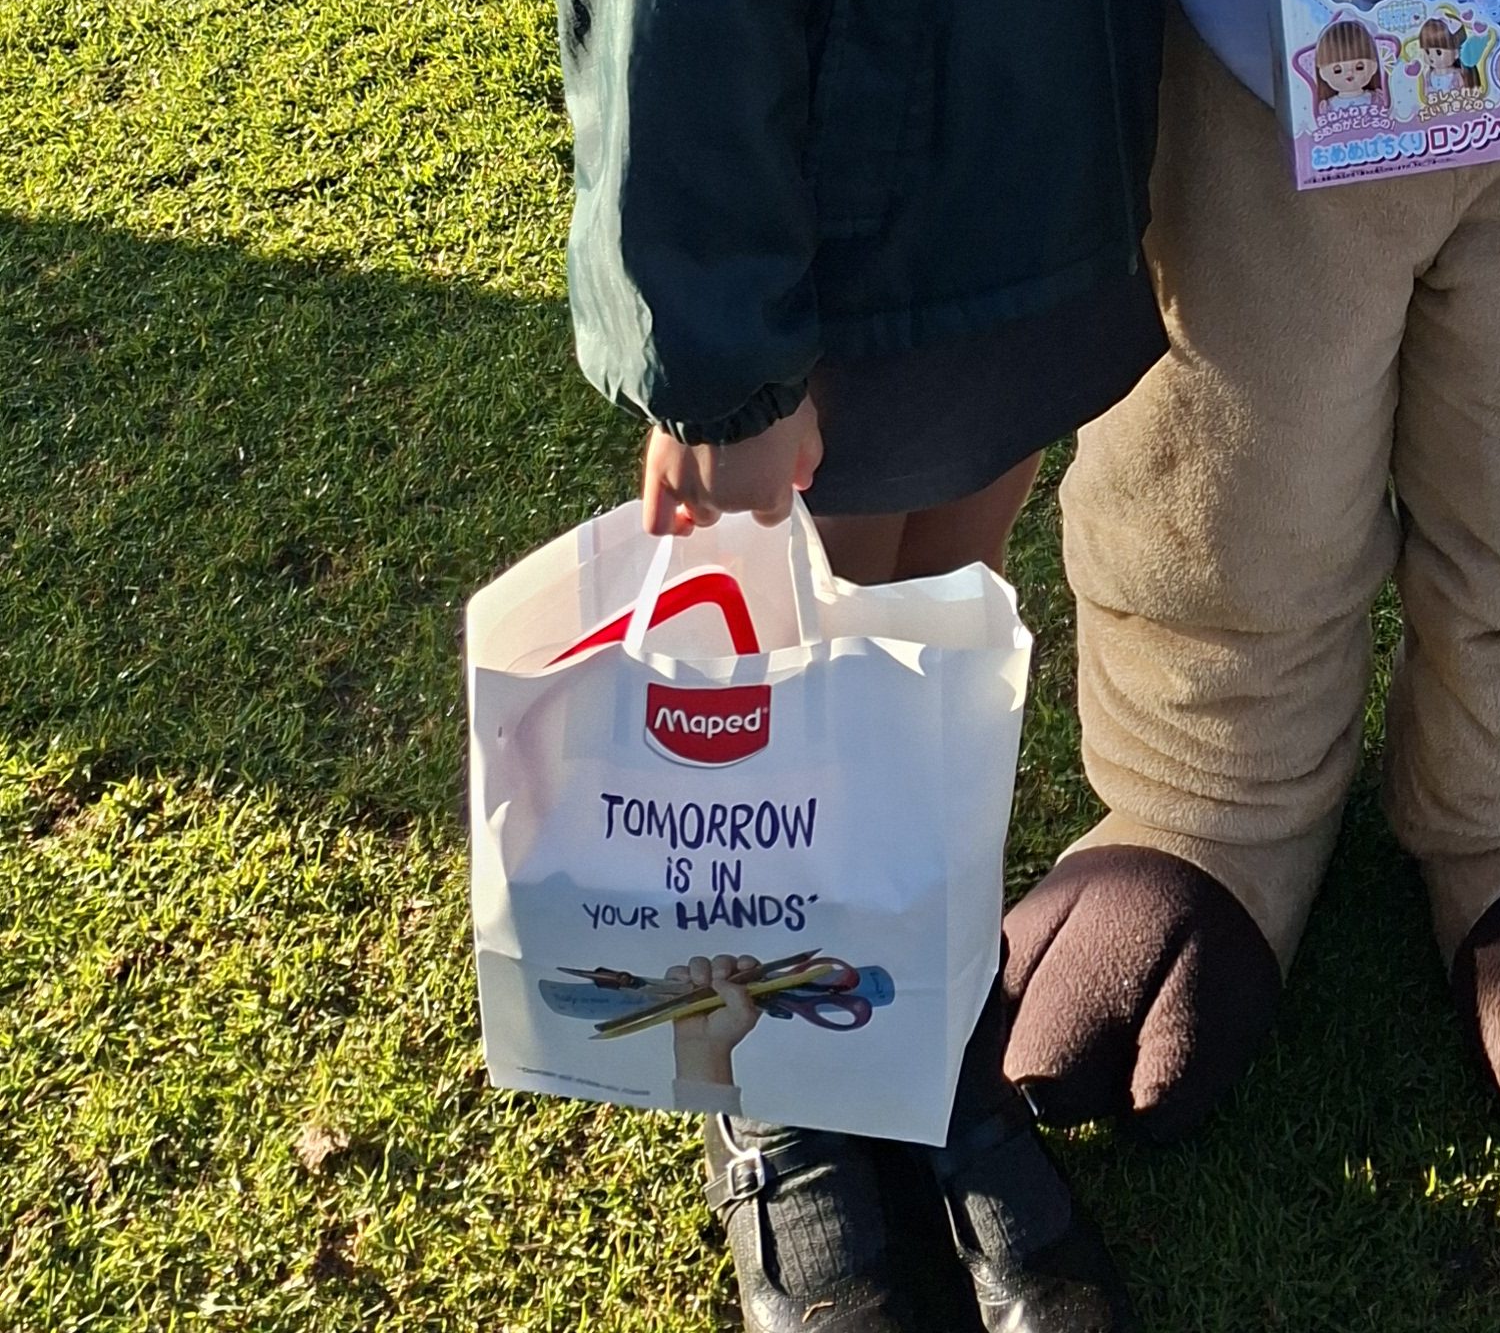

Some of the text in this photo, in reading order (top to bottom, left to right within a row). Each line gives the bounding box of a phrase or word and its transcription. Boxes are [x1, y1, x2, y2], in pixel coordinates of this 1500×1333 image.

[653, 706, 761, 739] Maped
[600, 793, 817, 850] TOMORROW
[711, 858, 742, 893] IN
[582, 901, 660, 931] YOUR
